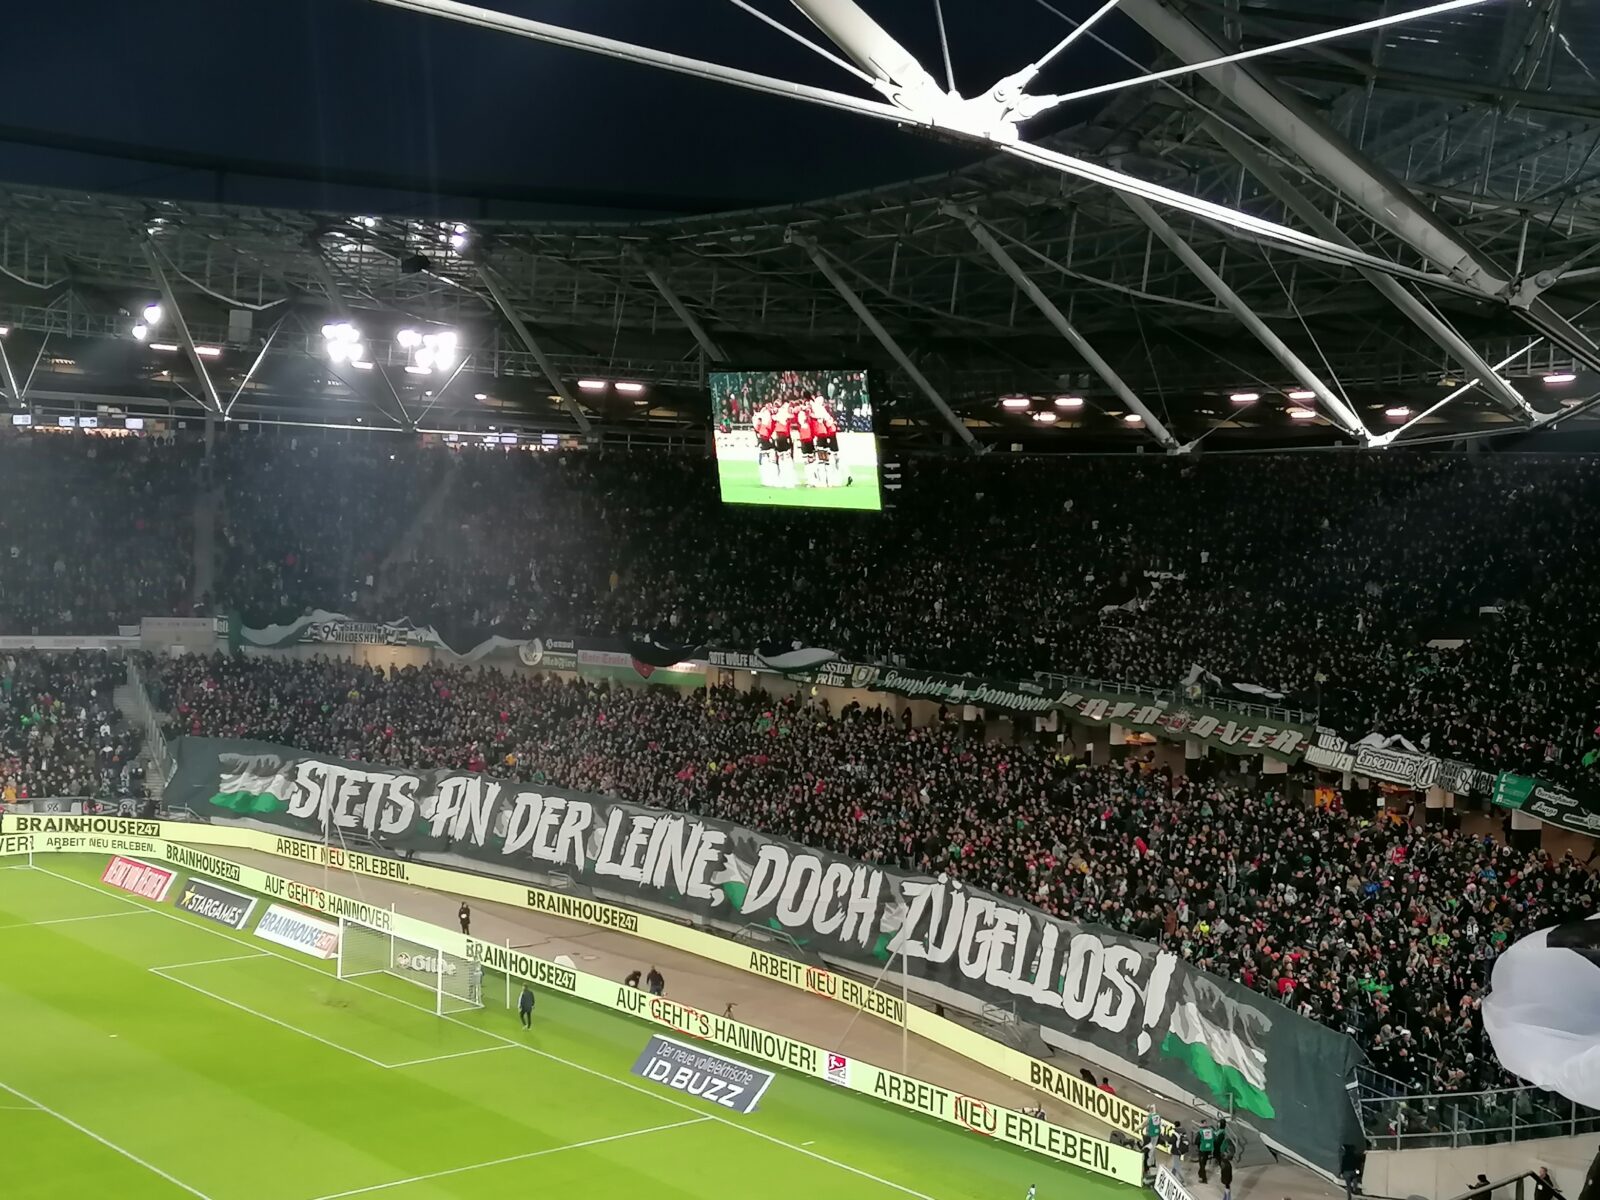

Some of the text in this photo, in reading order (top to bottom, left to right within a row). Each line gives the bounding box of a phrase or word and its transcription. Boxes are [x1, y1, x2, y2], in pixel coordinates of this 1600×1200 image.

[1356, 749, 1414, 776] Ensemble
[46, 837, 157, 853] ARBEIT NEU ERLEBEN.
[276, 837, 410, 881] ARBEIT NEU ERLEBEN.
[188, 893, 242, 925] STARGAMES
[264, 874, 286, 896] AUF
[287, 881, 326, 910] GEHT'S
[286, 760, 1178, 1057] STETS AN DER LEINE, DOCH ZÜGELLOS!
[527, 889, 639, 933] BRAINHOUSE247
[749, 951, 802, 984] ARBEIT
[806, 971, 837, 997] NEU
[616, 987, 817, 1072] AUF GEHT'S HANNOVER!
[656, 1041, 754, 1086] Der neue vollelektrische
[873, 1071, 1118, 1175] ARBEIT NEU ERLEBEN.
